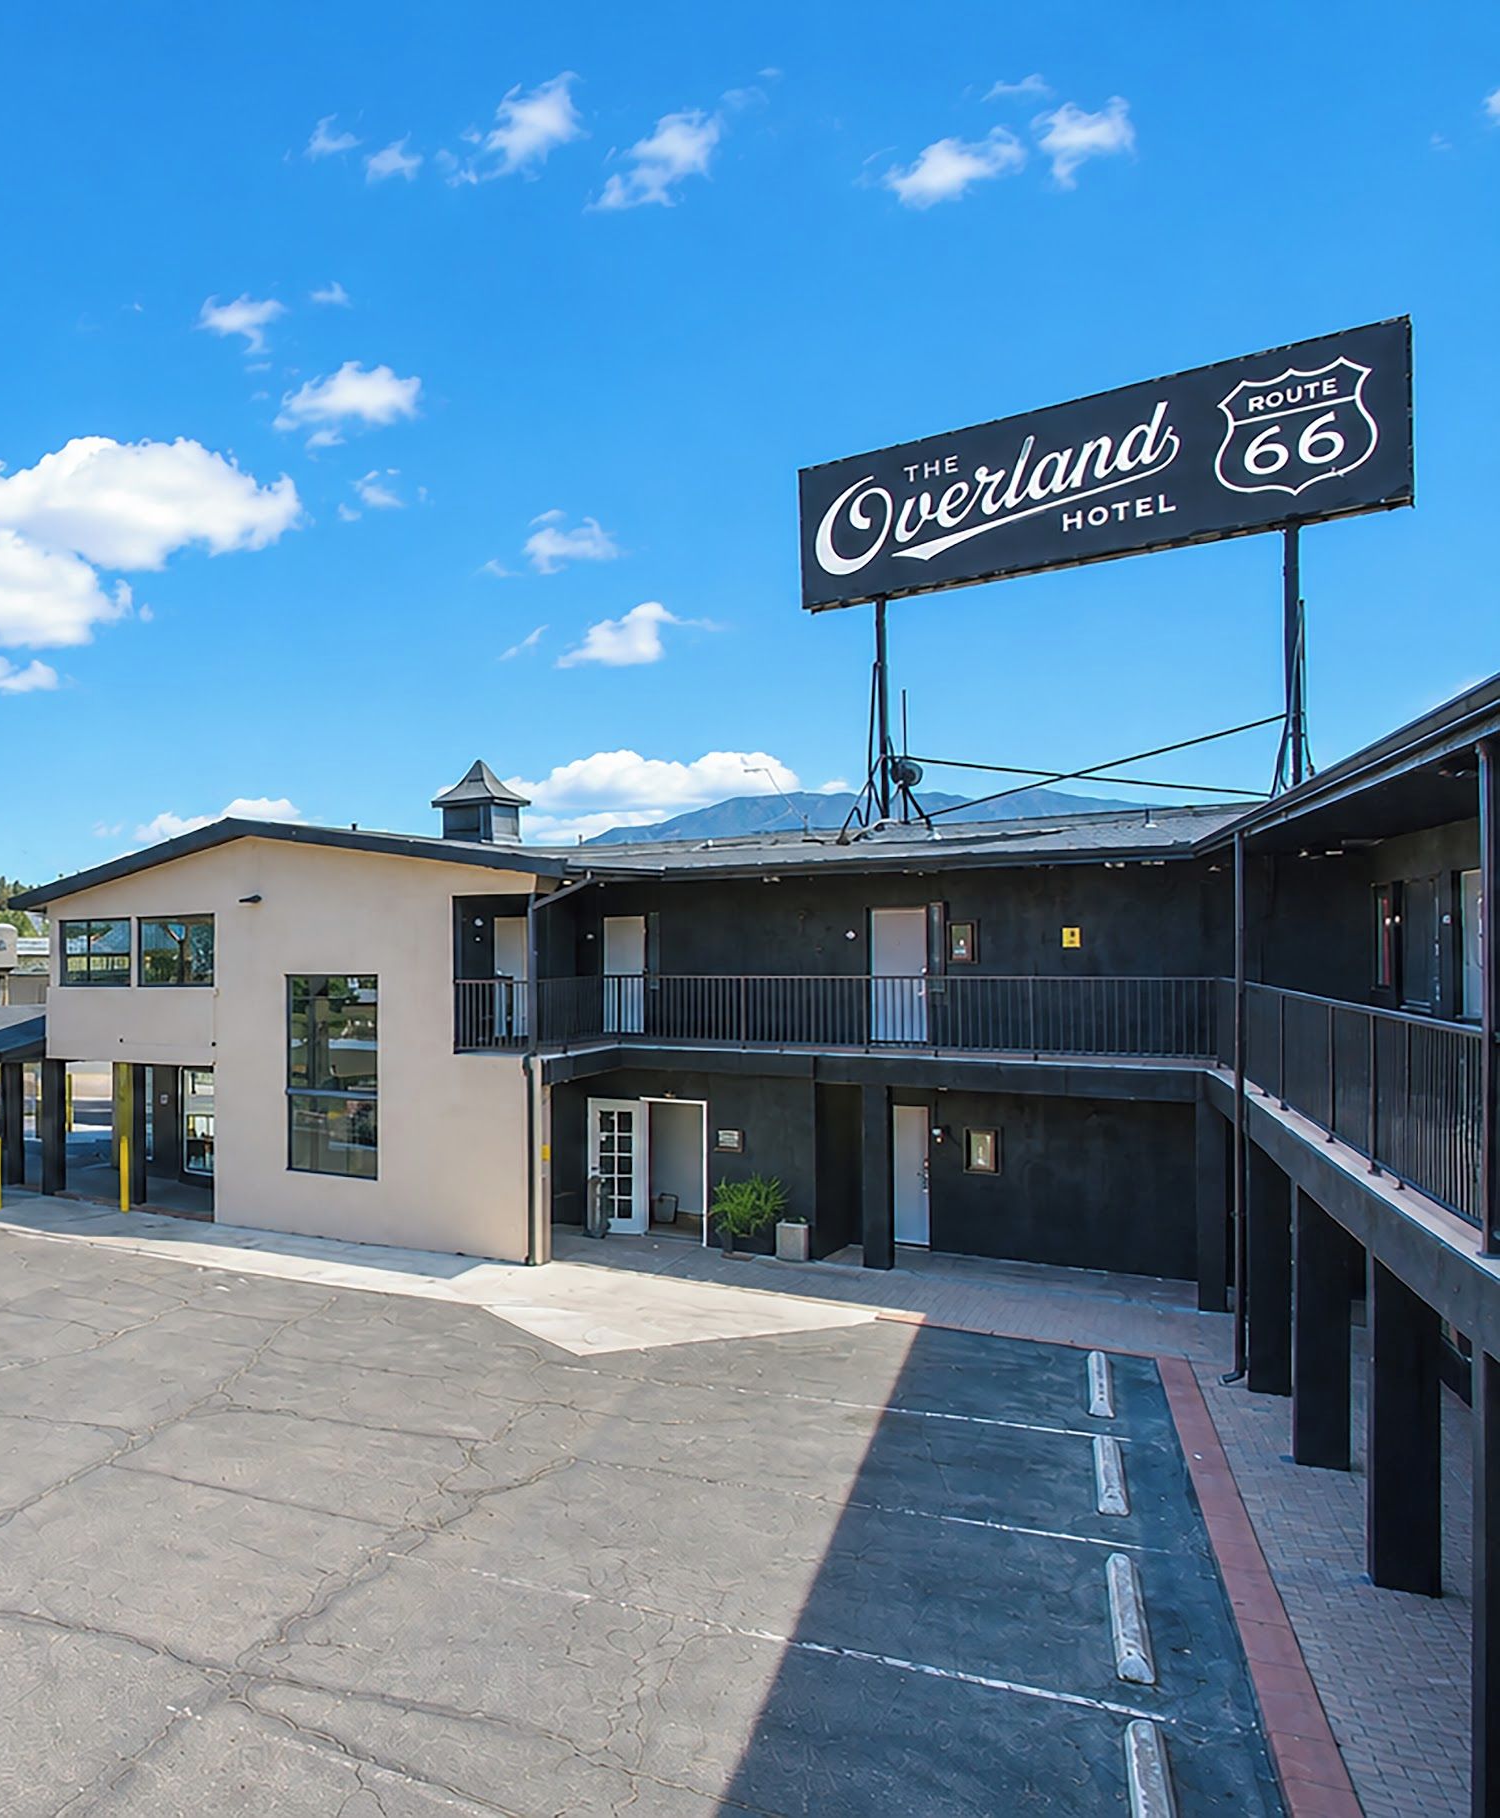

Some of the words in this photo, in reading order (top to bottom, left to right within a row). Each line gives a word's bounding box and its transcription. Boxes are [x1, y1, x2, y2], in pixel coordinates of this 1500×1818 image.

[1248, 378, 1338, 412] ROUTE
[1244, 411, 1345, 475] 66
[903, 455, 959, 482] THE
[815, 401, 1180, 575] Overland
[1062, 494, 1177, 532] HOTEL
